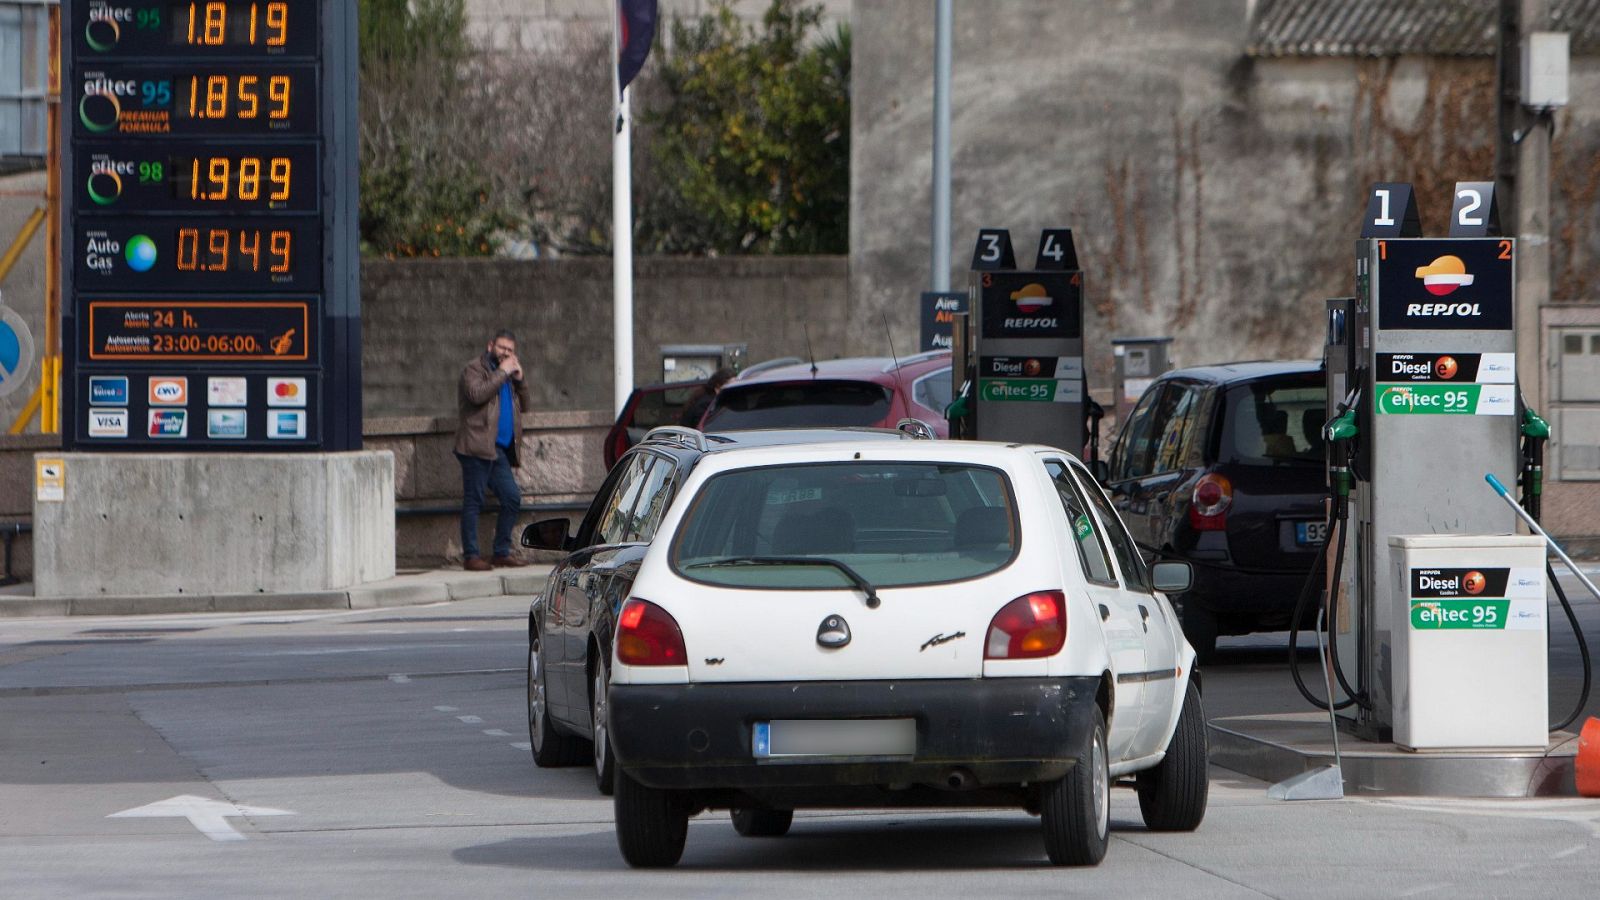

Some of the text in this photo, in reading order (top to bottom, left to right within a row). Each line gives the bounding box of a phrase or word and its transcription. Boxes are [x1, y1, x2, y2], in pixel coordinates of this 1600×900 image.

[137, 8, 160, 30] 95
[142, 80, 170, 107] 95
[190, 75, 290, 119] 1.859
[119, 111, 169, 122] PREMIUM
[139, 161, 163, 182] 98
[191, 157, 291, 200] 1.989
[1374, 189, 1395, 226] 1
[1457, 189, 1483, 226] 2
[87, 238, 119, 254] Auto
[177, 228, 291, 272] 0.949
[980, 234, 1000, 262] 3
[1042, 234, 1064, 261] 4
[1378, 241, 1387, 260] 1
[1498, 240, 1512, 260] 2
[86, 253, 112, 269] Gas
[983, 274, 992, 287] 3
[1070, 274, 1080, 287] 4
[935, 297, 960, 310] Aire
[1406, 302, 1482, 316] REPSOL
[153, 309, 198, 328] 24 h.
[1004, 318, 1058, 328] REPSOL
[993, 362, 1022, 372] Diesel
[1392, 361, 1431, 374] Diesel
[992, 383, 1029, 396] efitec
[1030, 384, 1049, 397] 95
[1391, 391, 1440, 407] efitec
[1443, 391, 1468, 408] 95
[97, 417, 121, 428] VISA
[1420, 576, 1459, 590] Diesel
[1420, 606, 1469, 622] efitec
[1472, 605, 1497, 623] 95
